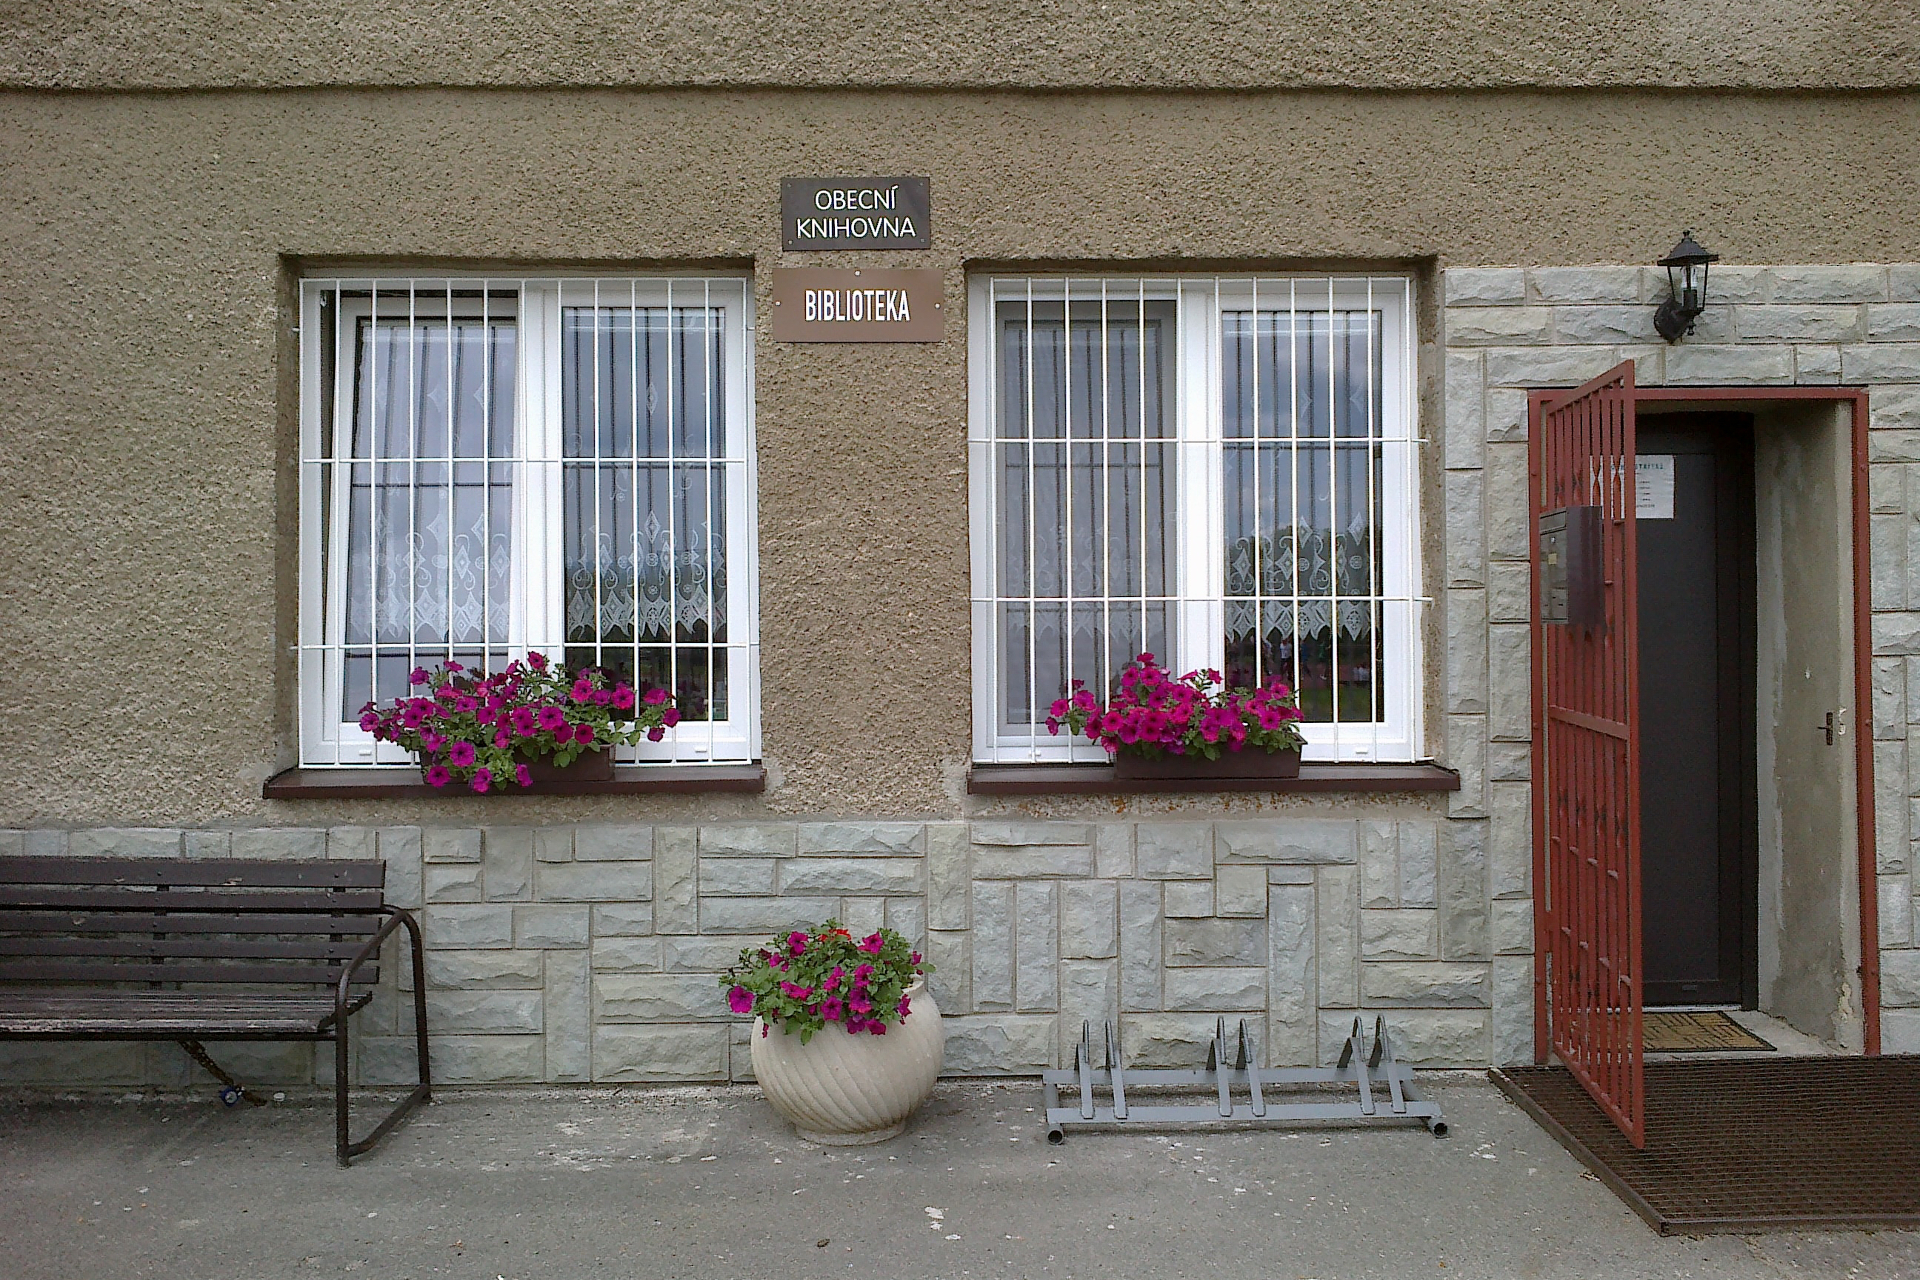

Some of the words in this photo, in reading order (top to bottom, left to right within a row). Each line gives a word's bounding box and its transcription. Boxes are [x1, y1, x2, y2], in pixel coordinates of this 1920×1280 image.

[815, 185, 899, 211] OBECNÍ
[796, 217, 916, 238] KNIHOVNA
[805, 289, 910, 321] BIBLIOTEKA
